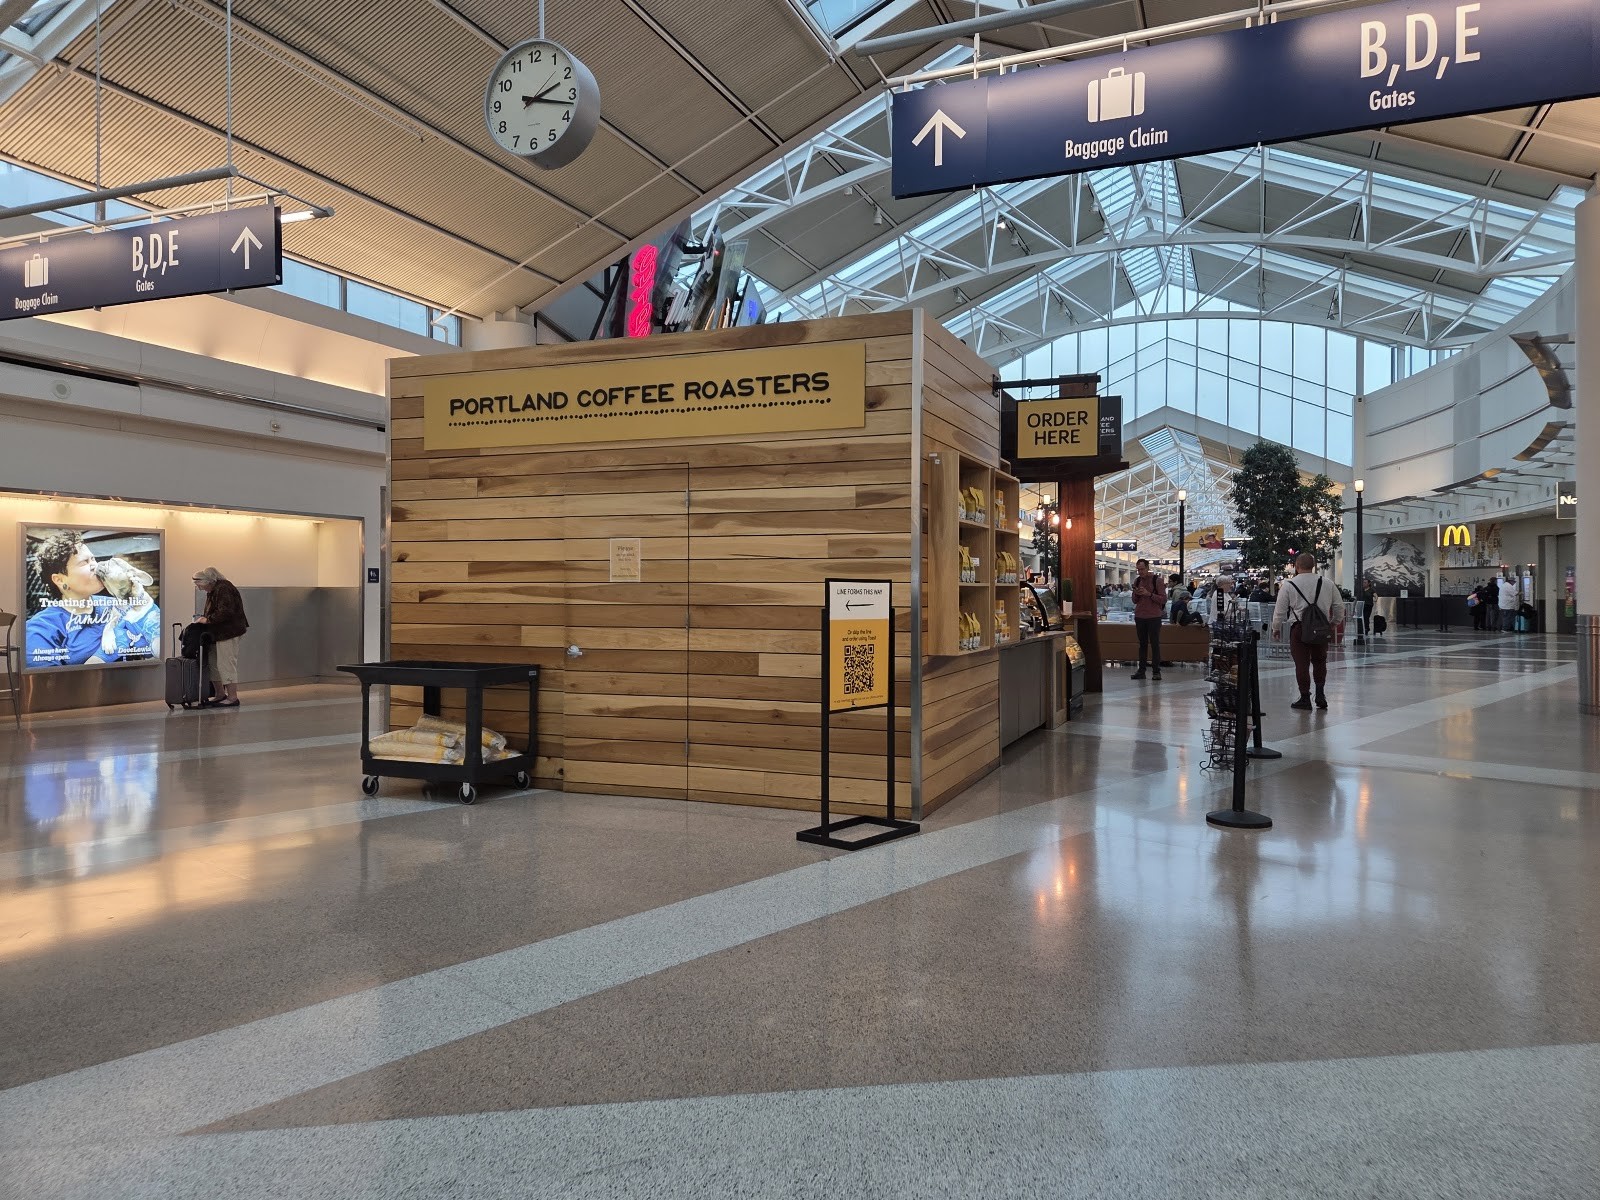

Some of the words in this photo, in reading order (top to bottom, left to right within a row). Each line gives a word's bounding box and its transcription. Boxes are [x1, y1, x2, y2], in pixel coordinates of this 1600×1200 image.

[1360, 3, 1480, 87] B,D,E
[528, 49, 542, 64] 12
[551, 53, 557, 66] 1
[511, 59, 522, 73] 11
[563, 66, 572, 80] 2
[498, 79, 512, 93] 10
[568, 88, 577, 101] 3
[1369, 90, 1416, 111] Gates
[493, 100, 502, 113] 9
[562, 110, 571, 122] 4
[498, 120, 507, 134] 8
[512, 135, 520, 148] 7
[548, 129, 557, 141] 5
[529, 137, 538, 150] 6
[1065, 137, 1125, 160] Baggage
[1129, 126, 1168, 148] Claim
[132, 229, 179, 278] B,D,E
[135, 279, 155, 292] Gates
[15, 296, 41, 311] Baggage
[41, 292, 59, 306] Claim
[450, 391, 569, 417] PORTLAND
[577, 382, 675, 408] COFFEE
[684, 371, 830, 401] ROASTERS
[1027, 410, 1089, 428] ORDER
[1034, 429, 1081, 446] HERE
[39, 597, 85, 608] Treating
[86, 597, 128, 608] patients
[128, 596, 148, 606] like
[66, 607, 116, 632] family
